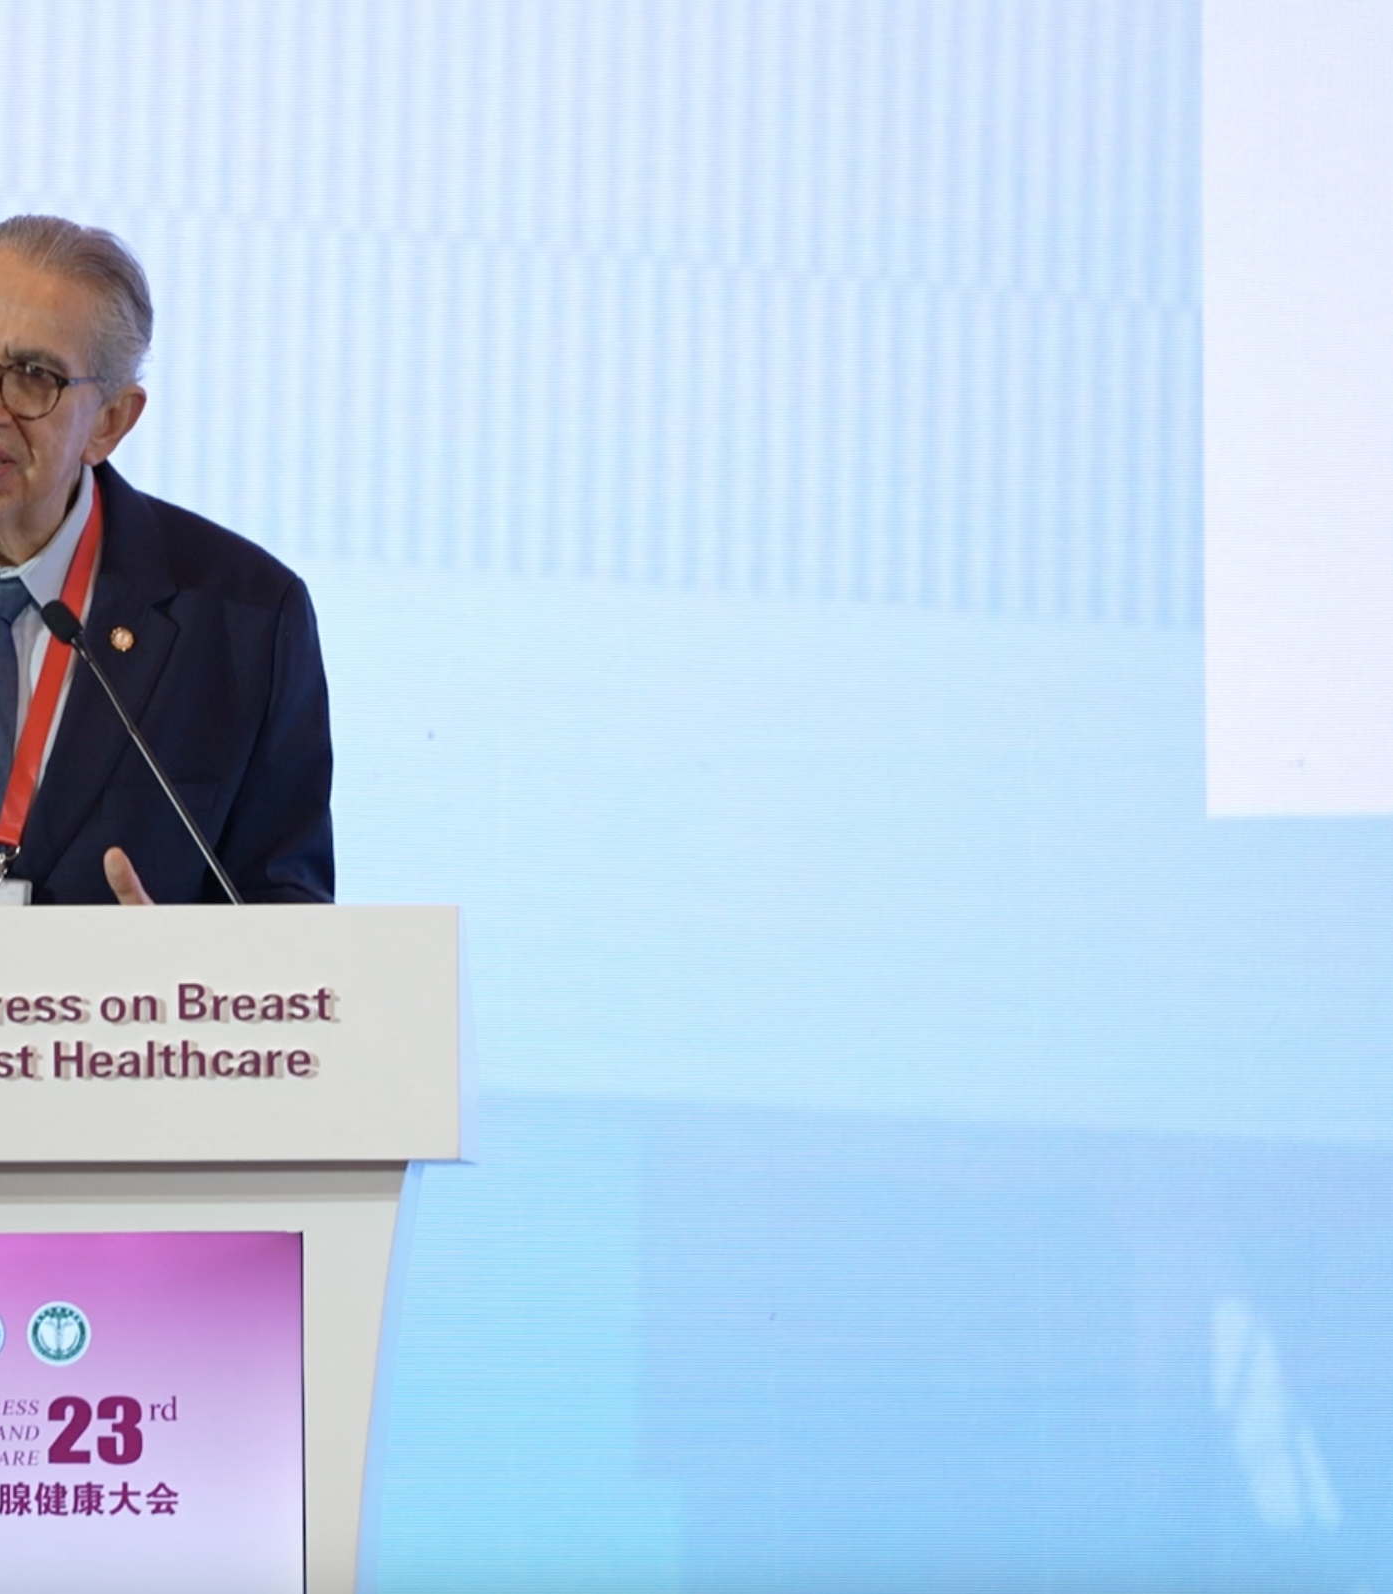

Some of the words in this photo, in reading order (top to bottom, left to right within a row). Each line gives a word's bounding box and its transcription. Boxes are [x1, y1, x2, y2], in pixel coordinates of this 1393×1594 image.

[99, 995, 159, 1023] on
[177, 983, 332, 1022] Breast
[53, 1040, 312, 1079] Healthcare
